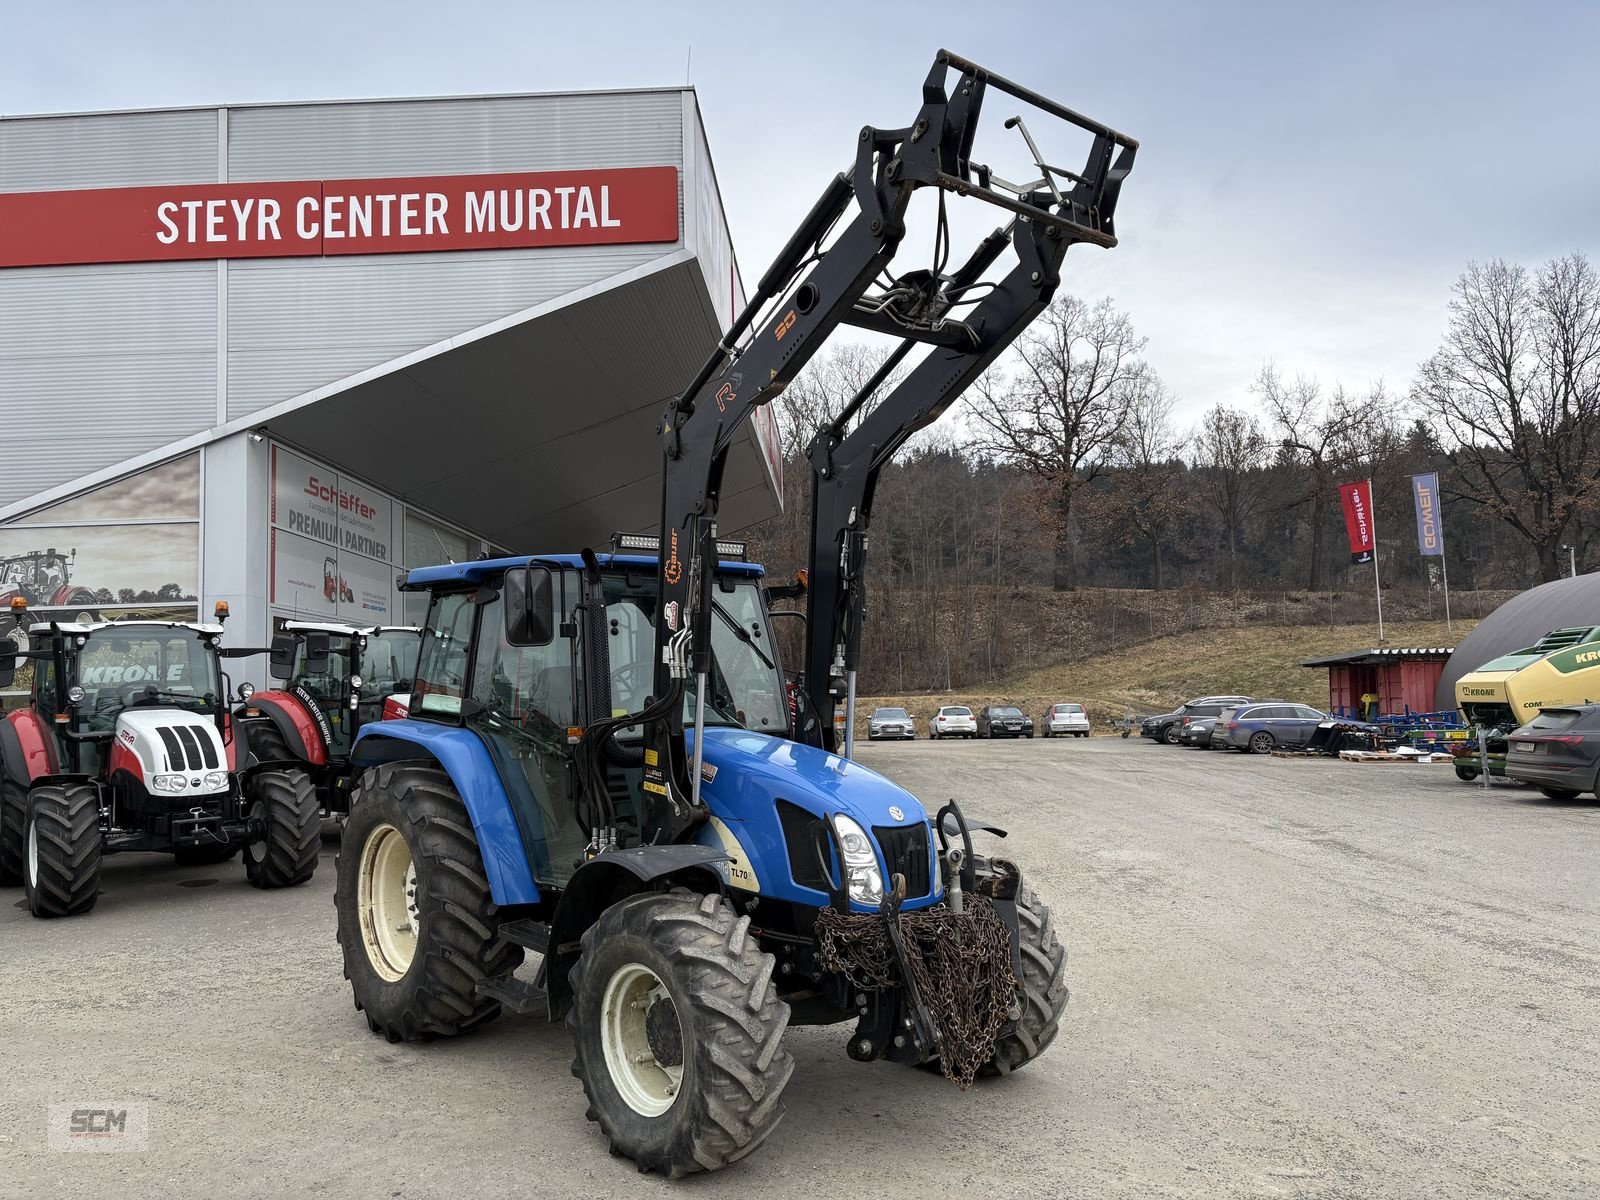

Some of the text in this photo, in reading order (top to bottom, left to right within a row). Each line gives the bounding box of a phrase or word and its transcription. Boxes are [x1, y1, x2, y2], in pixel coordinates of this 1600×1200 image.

[155, 185, 621, 245] STEYR CENTER MURTAL
[304, 476, 376, 521] Schäffer
[289, 509, 343, 546] PREMIUM
[345, 530, 386, 561] PARTNER
[1576, 650, 1600, 664] KR
[1470, 688, 1496, 697] KRONE
[308, 699, 323, 723] CENTER
[120, 729, 136, 745] STEYR
